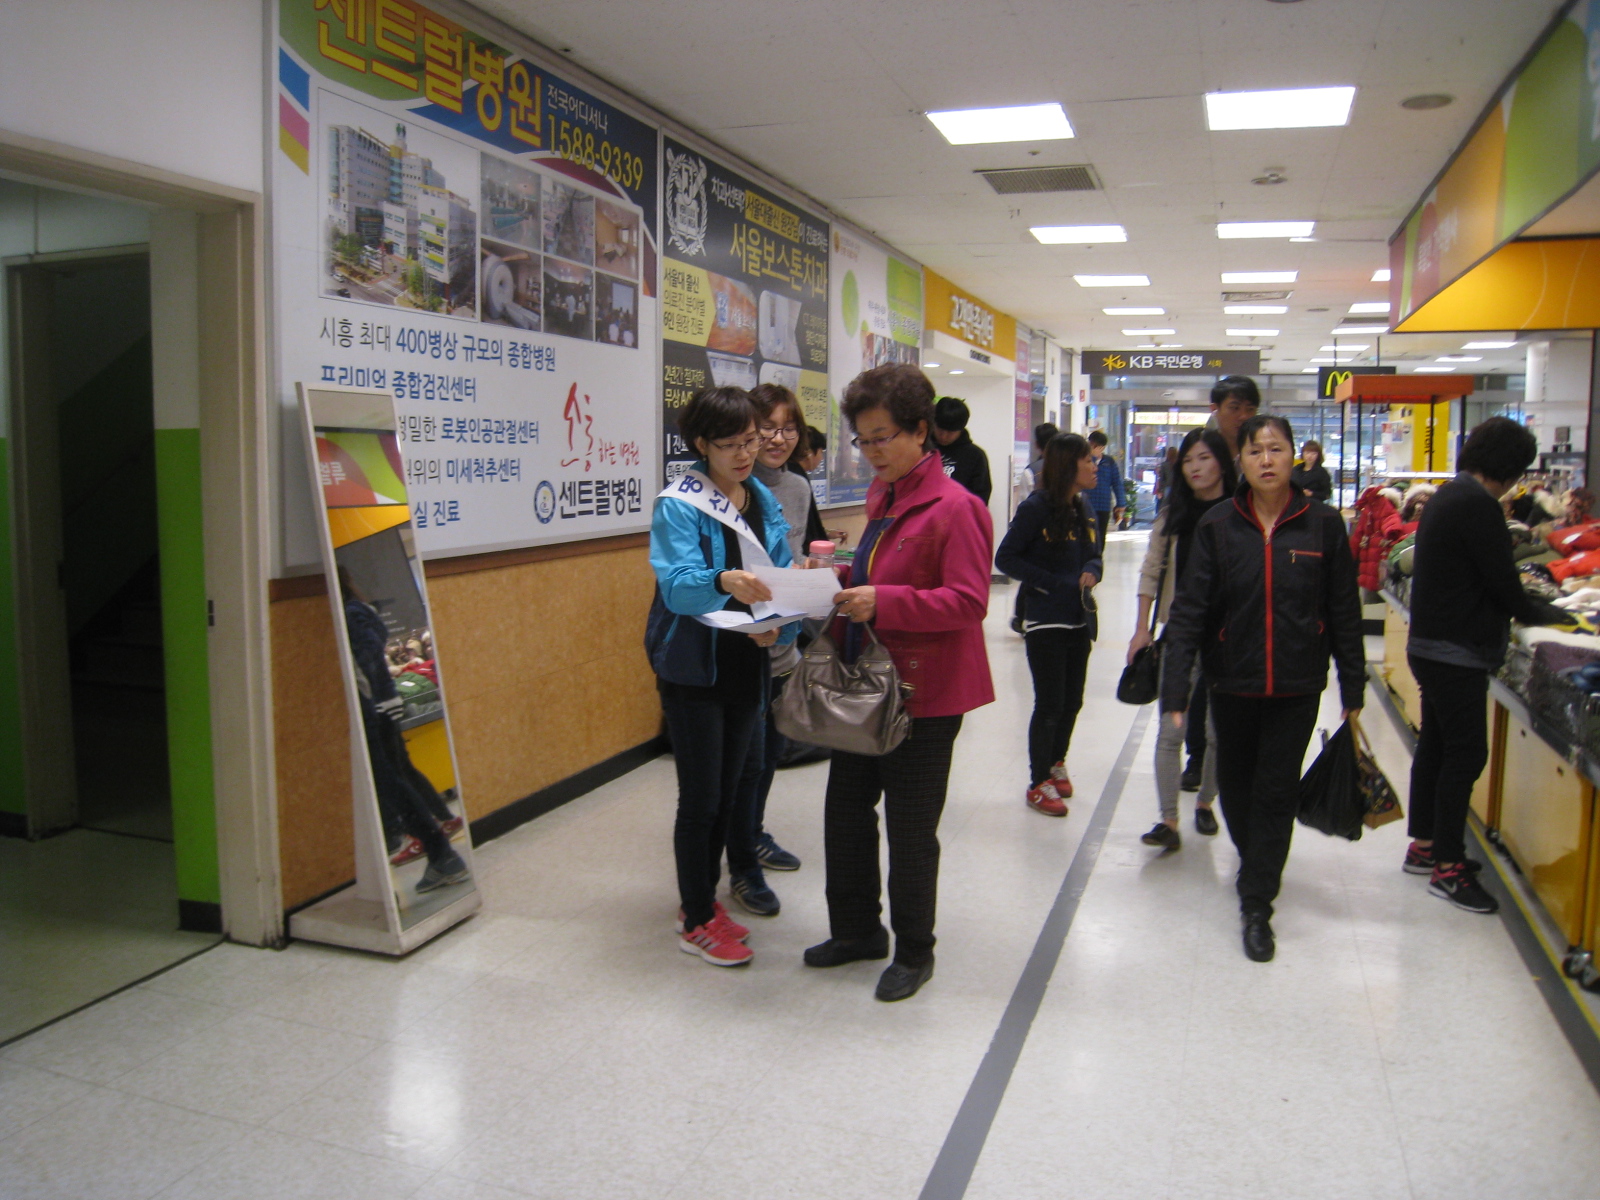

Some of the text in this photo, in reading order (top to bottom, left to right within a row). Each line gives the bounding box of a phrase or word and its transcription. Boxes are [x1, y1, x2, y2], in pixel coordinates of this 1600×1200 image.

[315, 0, 542, 148] 센트럴병원
[547, 83, 609, 134] 전국어디서나
[547, 113, 643, 191] 1588-9339
[730, 223, 828, 302] 서울보스톤치과
[319, 317, 556, 371] 시흥 최대 400병상 규모의 종합병원
[1130, 356, 1153, 369] KB
[1155, 355, 1204, 369] 국민은행
[392, 370, 477, 402] 종합검진센터
[441, 416, 539, 444] 로봇인공관절센터
[446, 459, 521, 484] 미세척추센터
[433, 500, 460, 526] 진료
[559, 477, 642, 519] 센트럴병원
